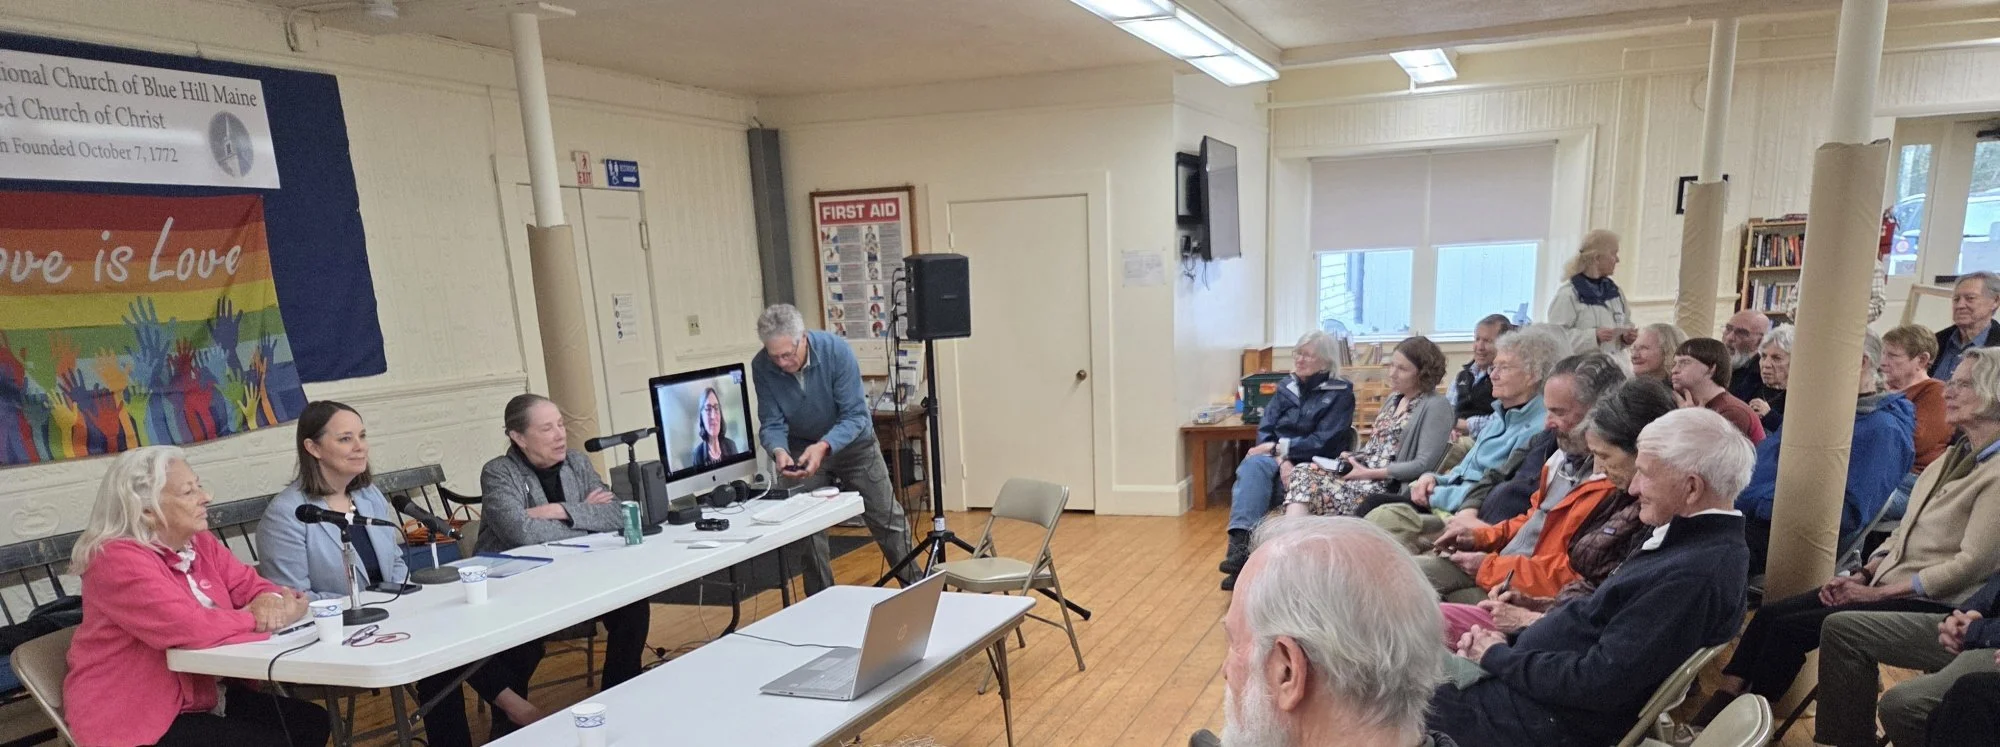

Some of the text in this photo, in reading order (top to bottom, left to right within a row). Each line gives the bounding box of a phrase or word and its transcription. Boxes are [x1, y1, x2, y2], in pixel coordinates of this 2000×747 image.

[0, 61, 257, 106] ional Church of Blue Hill Maine
[22, 97, 91, 123] Church
[94, 104, 112, 125] of
[115, 106, 166, 129] Christ
[12, 137, 76, 157] Founded
[78, 141, 131, 160] October
[134, 145, 147, 163] 7,
[149, 146, 178, 162] 1772
[577, 171, 592, 185] EXIT
[822, 202, 897, 221] FIRST AID
[94, 230, 134, 283] is
[148, 216, 242, 282] Love
